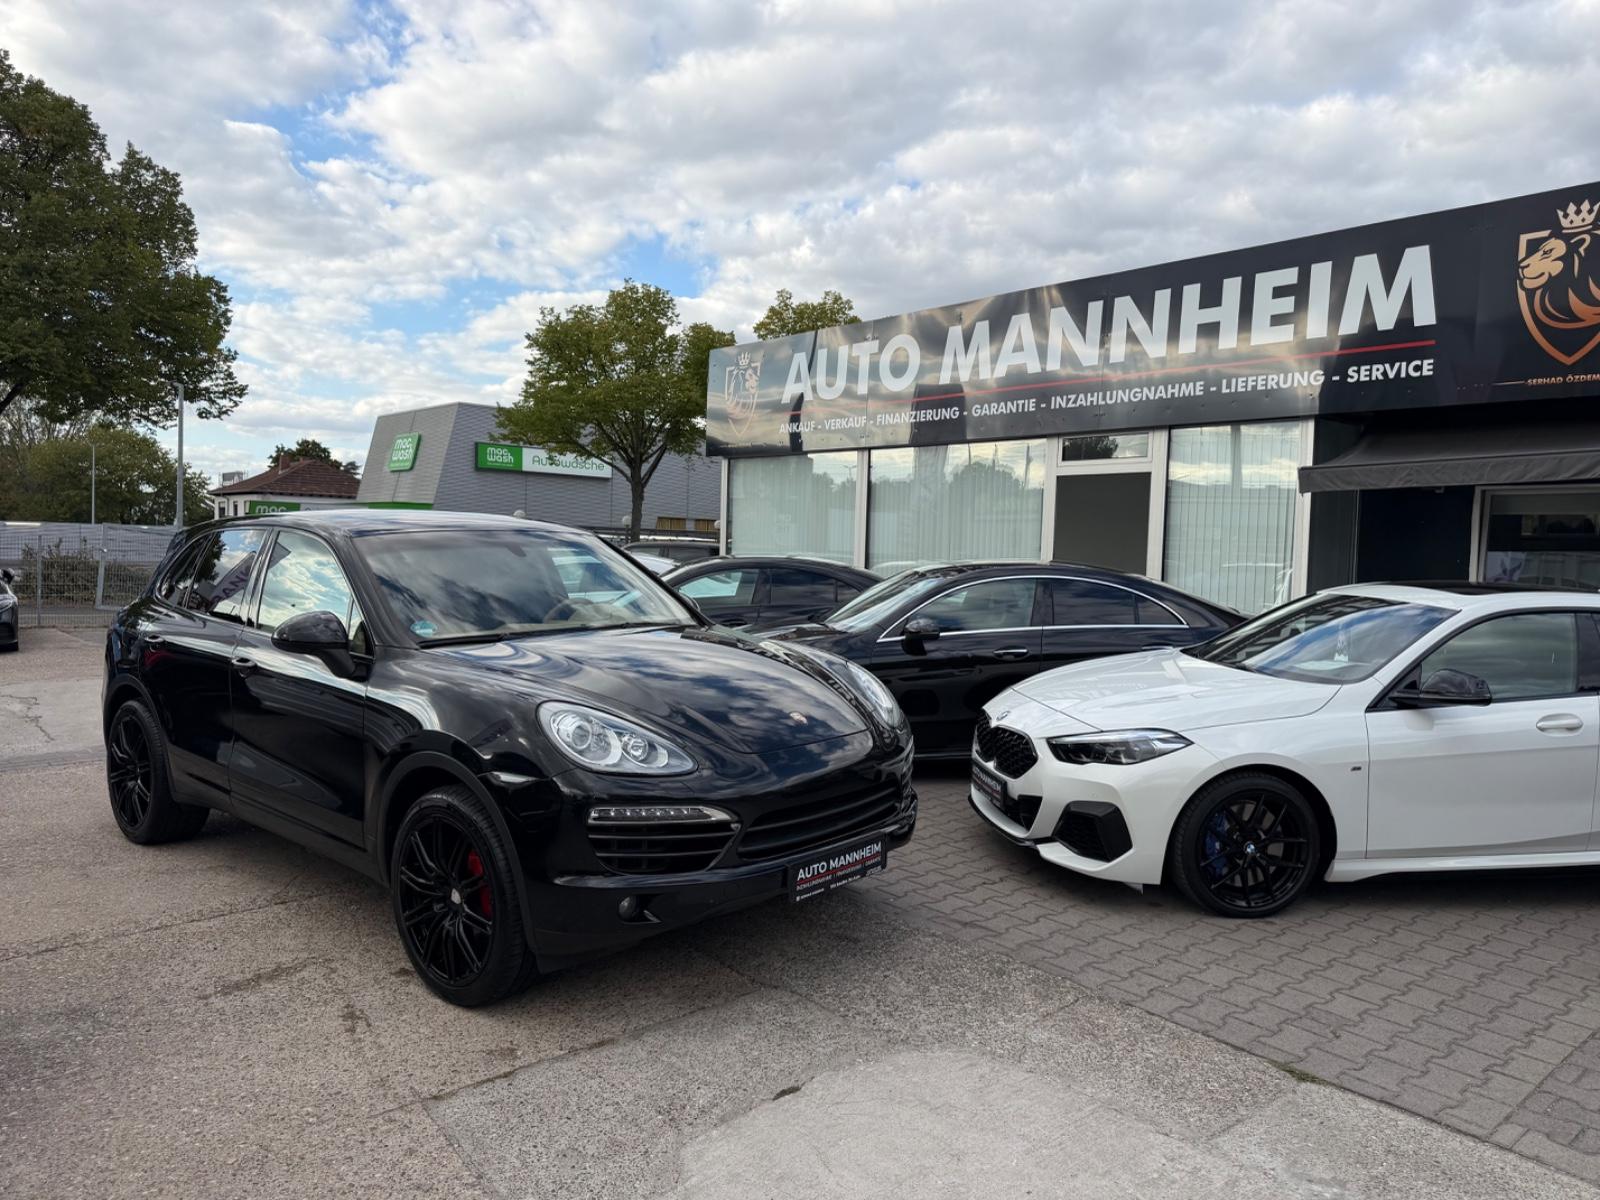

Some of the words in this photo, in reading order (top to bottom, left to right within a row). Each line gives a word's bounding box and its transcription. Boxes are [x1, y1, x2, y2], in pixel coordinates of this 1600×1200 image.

[781, 335, 921, 404] AUTO
[938, 244, 1437, 385] MANNHEIM
[779, 421, 816, 435] ANKAUF
[824, 416, 867, 430] VERKAUF
[876, 407, 960, 426] FINANZIERUNG
[971, 398, 1036, 418] GARANTIE
[1050, 381, 1204, 409] INZAHLUNGNAHME
[1221, 370, 1325, 394] LIEFERUNG
[1346, 359, 1434, 383] SERVICE
[1527, 376, 1563, 386] SERHAD
[797, 861, 827, 881] AUTO
[829, 841, 881, 870] MANNHEIM
